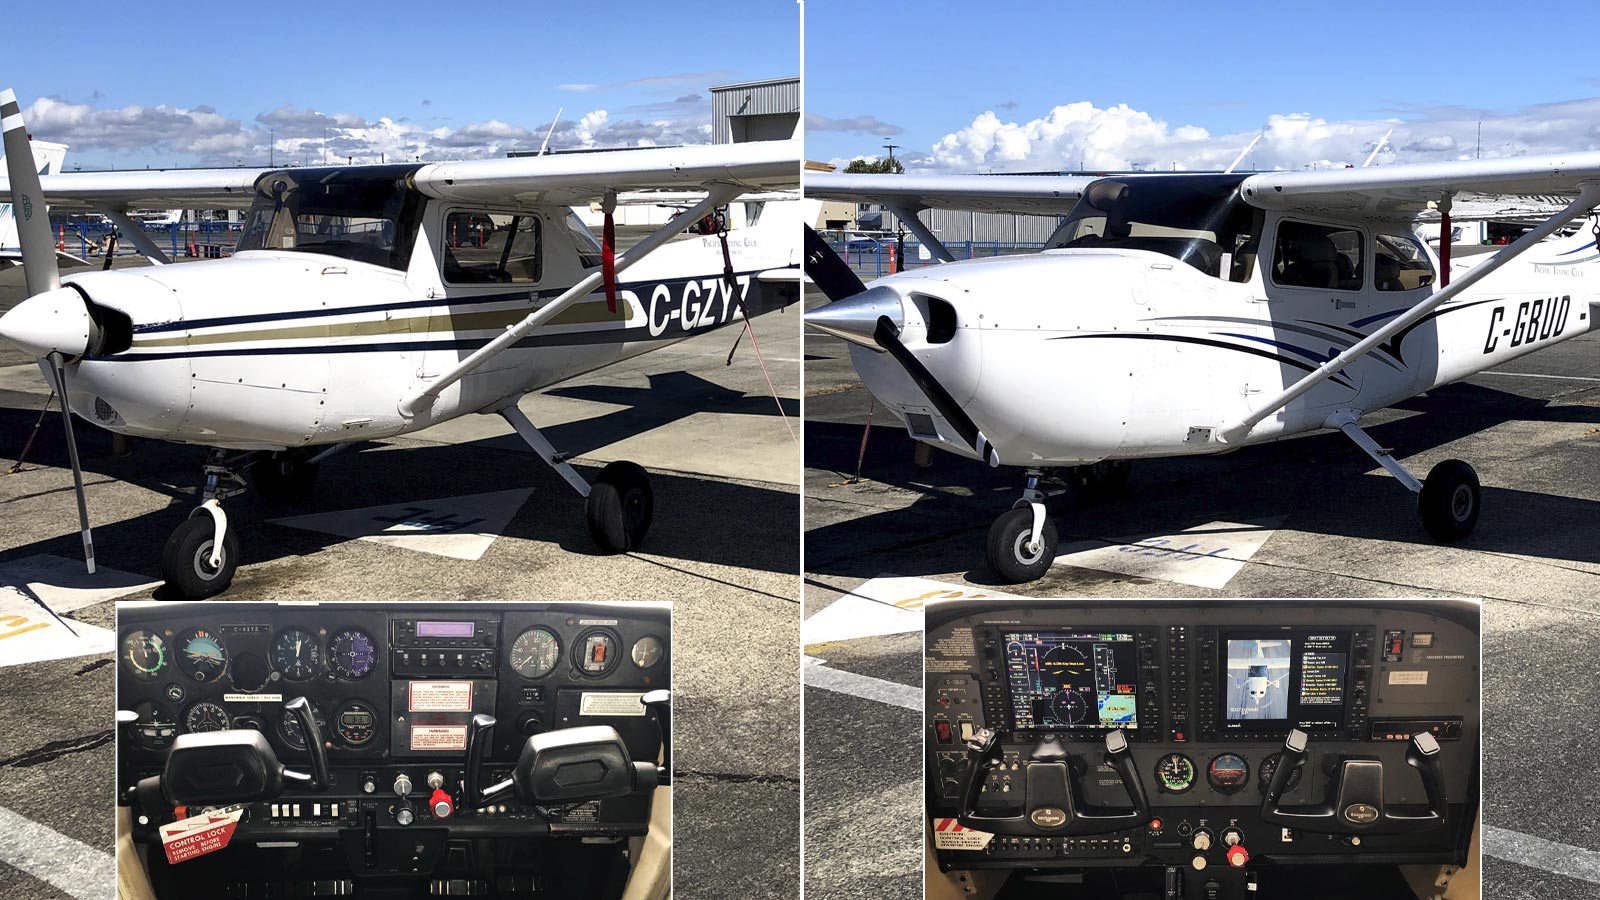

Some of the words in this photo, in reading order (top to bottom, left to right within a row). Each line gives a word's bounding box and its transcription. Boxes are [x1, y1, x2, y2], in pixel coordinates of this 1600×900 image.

[648, 275, 750, 337] C-GZYZ
[1483, 295, 1570, 354] C-GBUD
[169, 834, 206, 850] CONTROL
[206, 827, 226, 838] LOCK
[172, 844, 196, 856] REMOVE
[173, 849, 200, 861] STARTING
